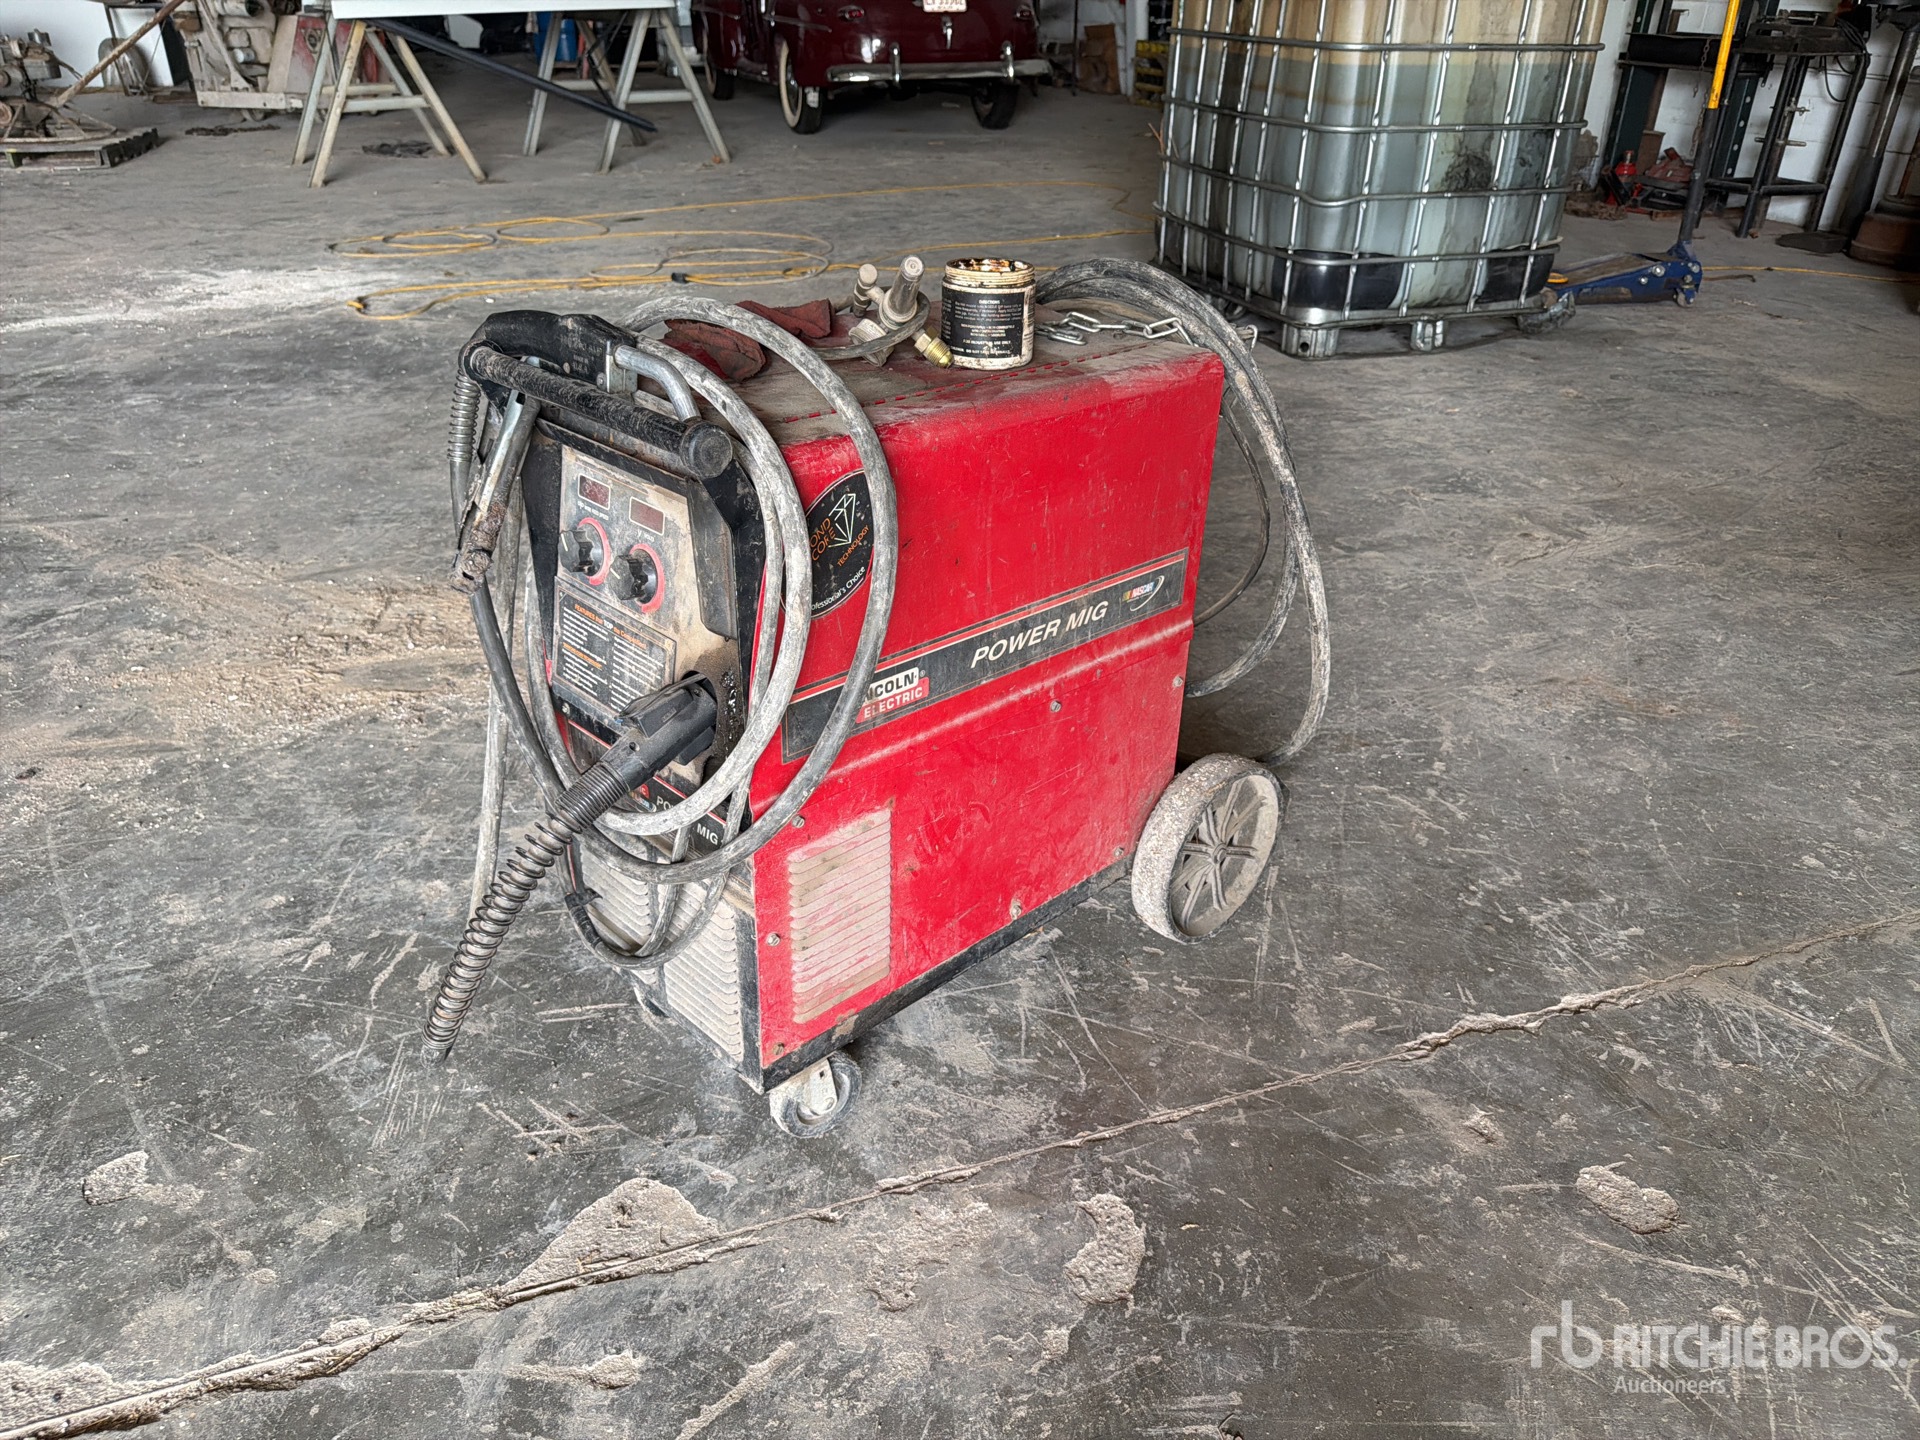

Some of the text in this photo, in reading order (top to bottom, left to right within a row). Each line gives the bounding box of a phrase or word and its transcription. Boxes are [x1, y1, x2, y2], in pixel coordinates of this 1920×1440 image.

[837, 524, 869, 566] TECHNOLOGY
[811, 566, 866, 611] ofessional's Choice
[970, 600, 1109, 668] POWER MIG
[863, 687, 923, 718] ELECTRIC
[866, 672, 915, 700] NCOLN
[696, 823, 719, 846] MIG
